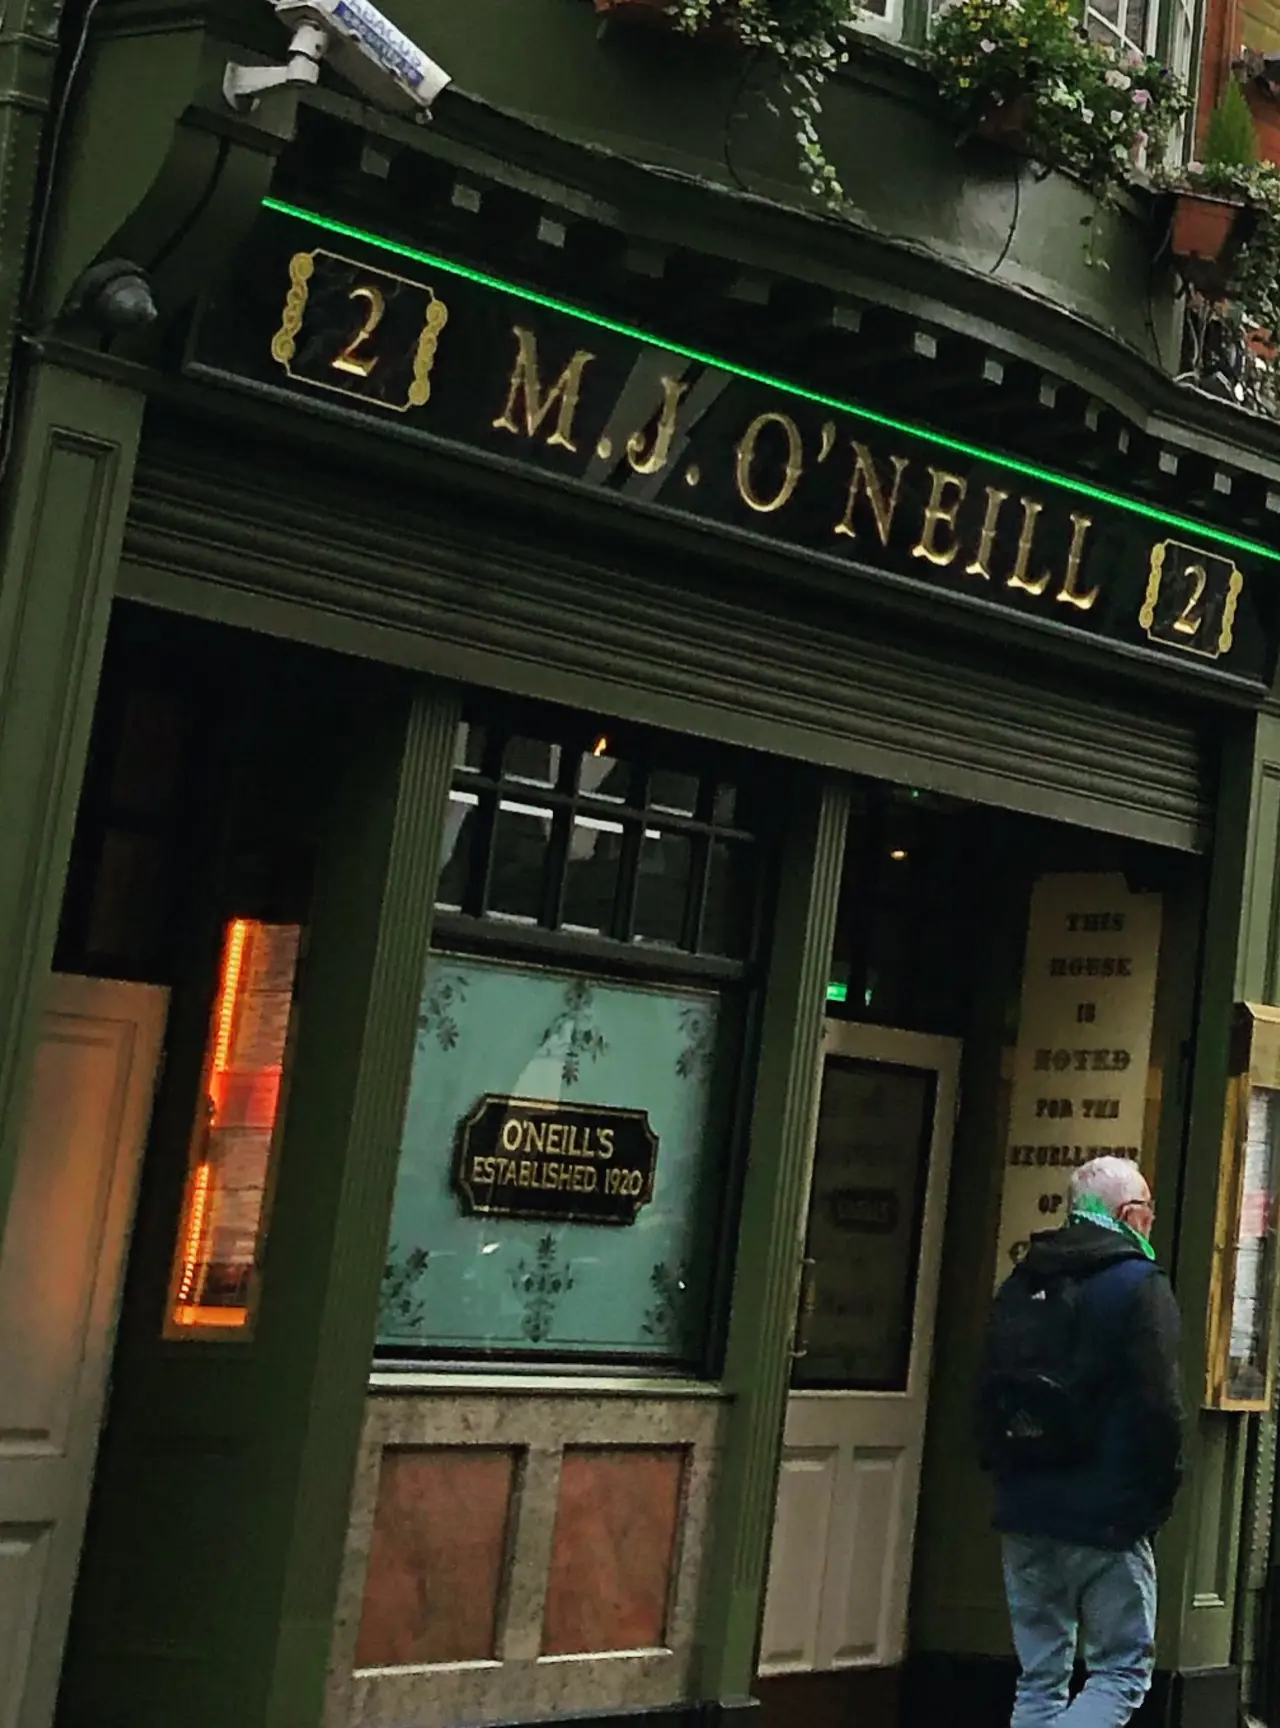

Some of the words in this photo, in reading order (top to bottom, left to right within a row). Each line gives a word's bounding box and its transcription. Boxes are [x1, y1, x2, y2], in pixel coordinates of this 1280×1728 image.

[332, 287, 387, 378] 2
[492, 325, 701, 486] M.J.
[736, 412, 1100, 610] O'NEILL
[1172, 564, 1207, 635] 2
[1066, 912, 1126, 932] THIS
[1049, 956, 1133, 978] HOUSE
[1034, 1048, 1131, 1072] NOTED
[502, 1118, 615, 1160] O'NEILL'S
[471, 1155, 599, 1193] ESTABLISHED
[604, 1167, 643, 1196] 1920
